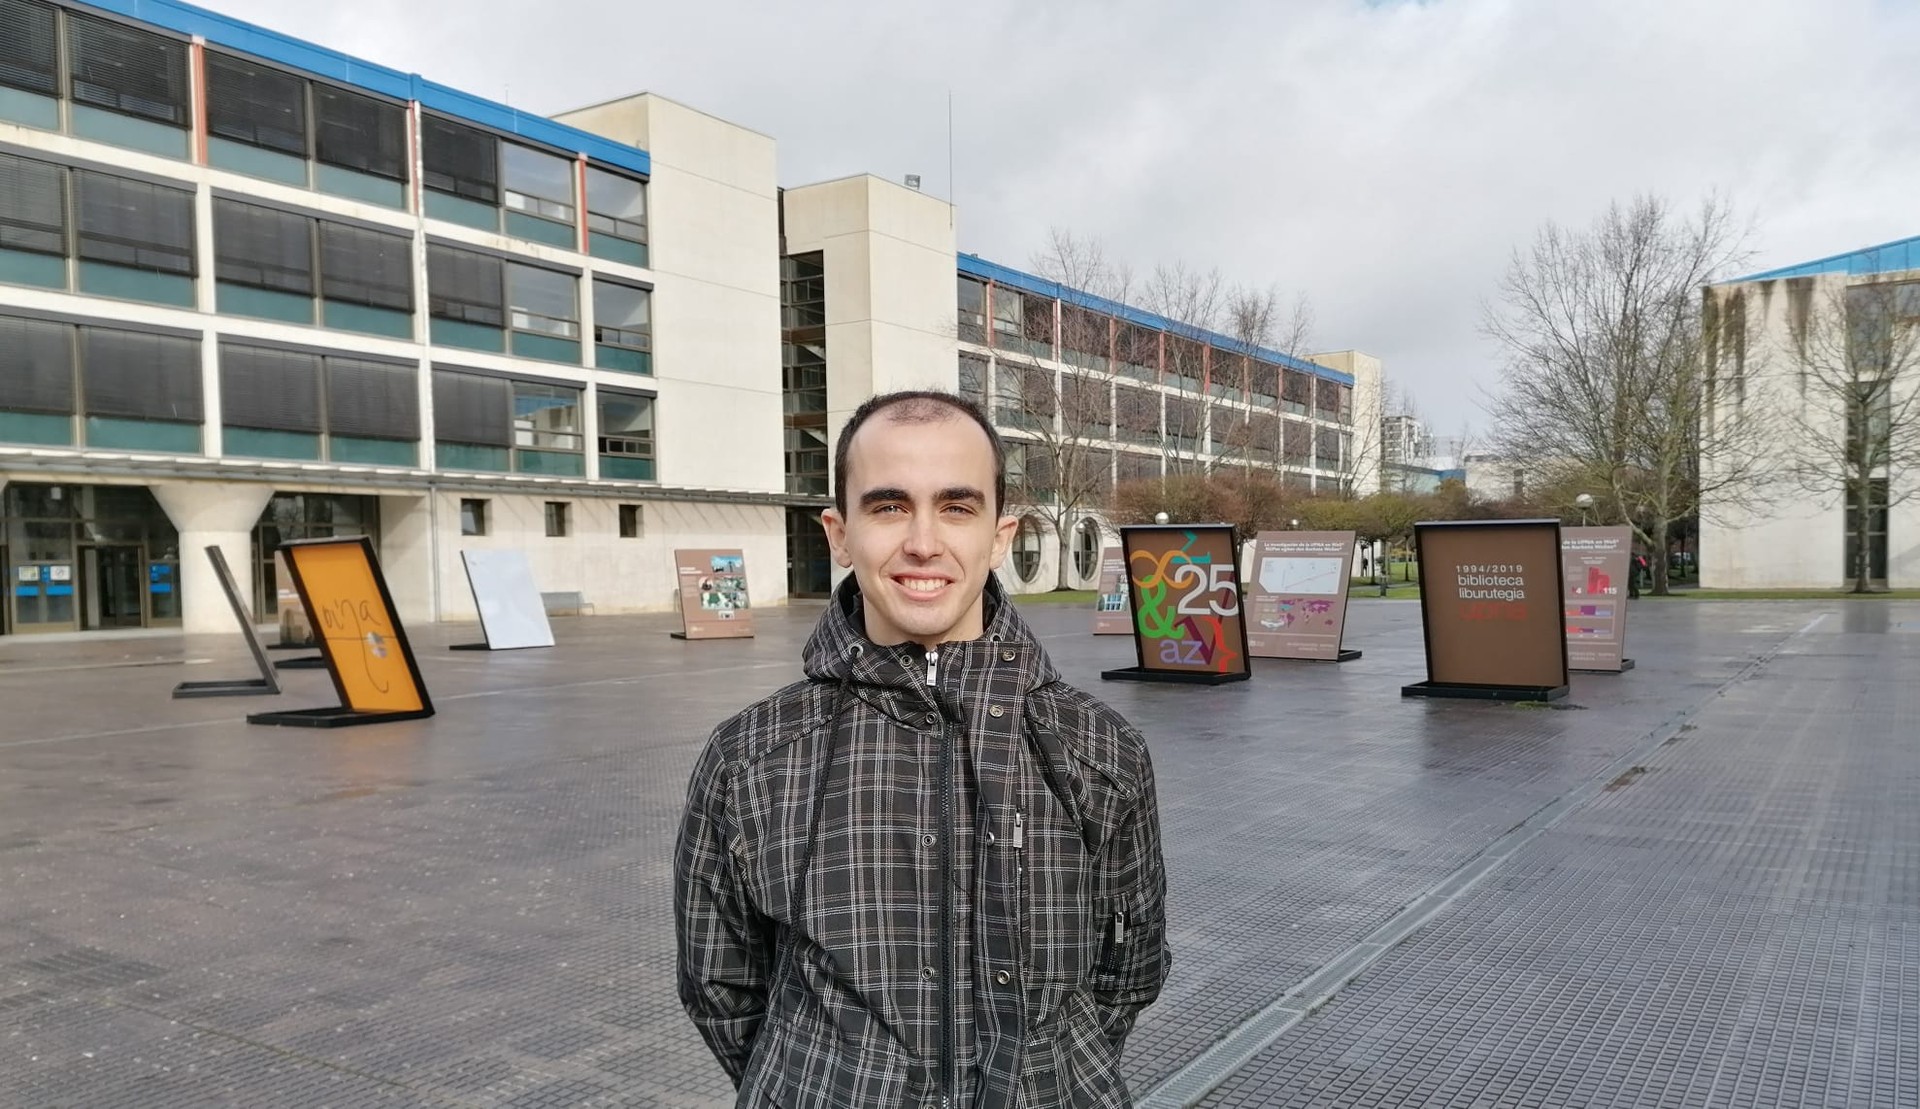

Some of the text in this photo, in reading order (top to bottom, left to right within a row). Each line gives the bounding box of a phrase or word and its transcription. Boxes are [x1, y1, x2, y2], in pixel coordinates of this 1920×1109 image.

[1456, 564, 1523, 573] 1994/2019
[1457, 574, 1525, 586] biblioteca
[1174, 564, 1239, 616] 25
[1458, 587, 1525, 602] liburutegia
